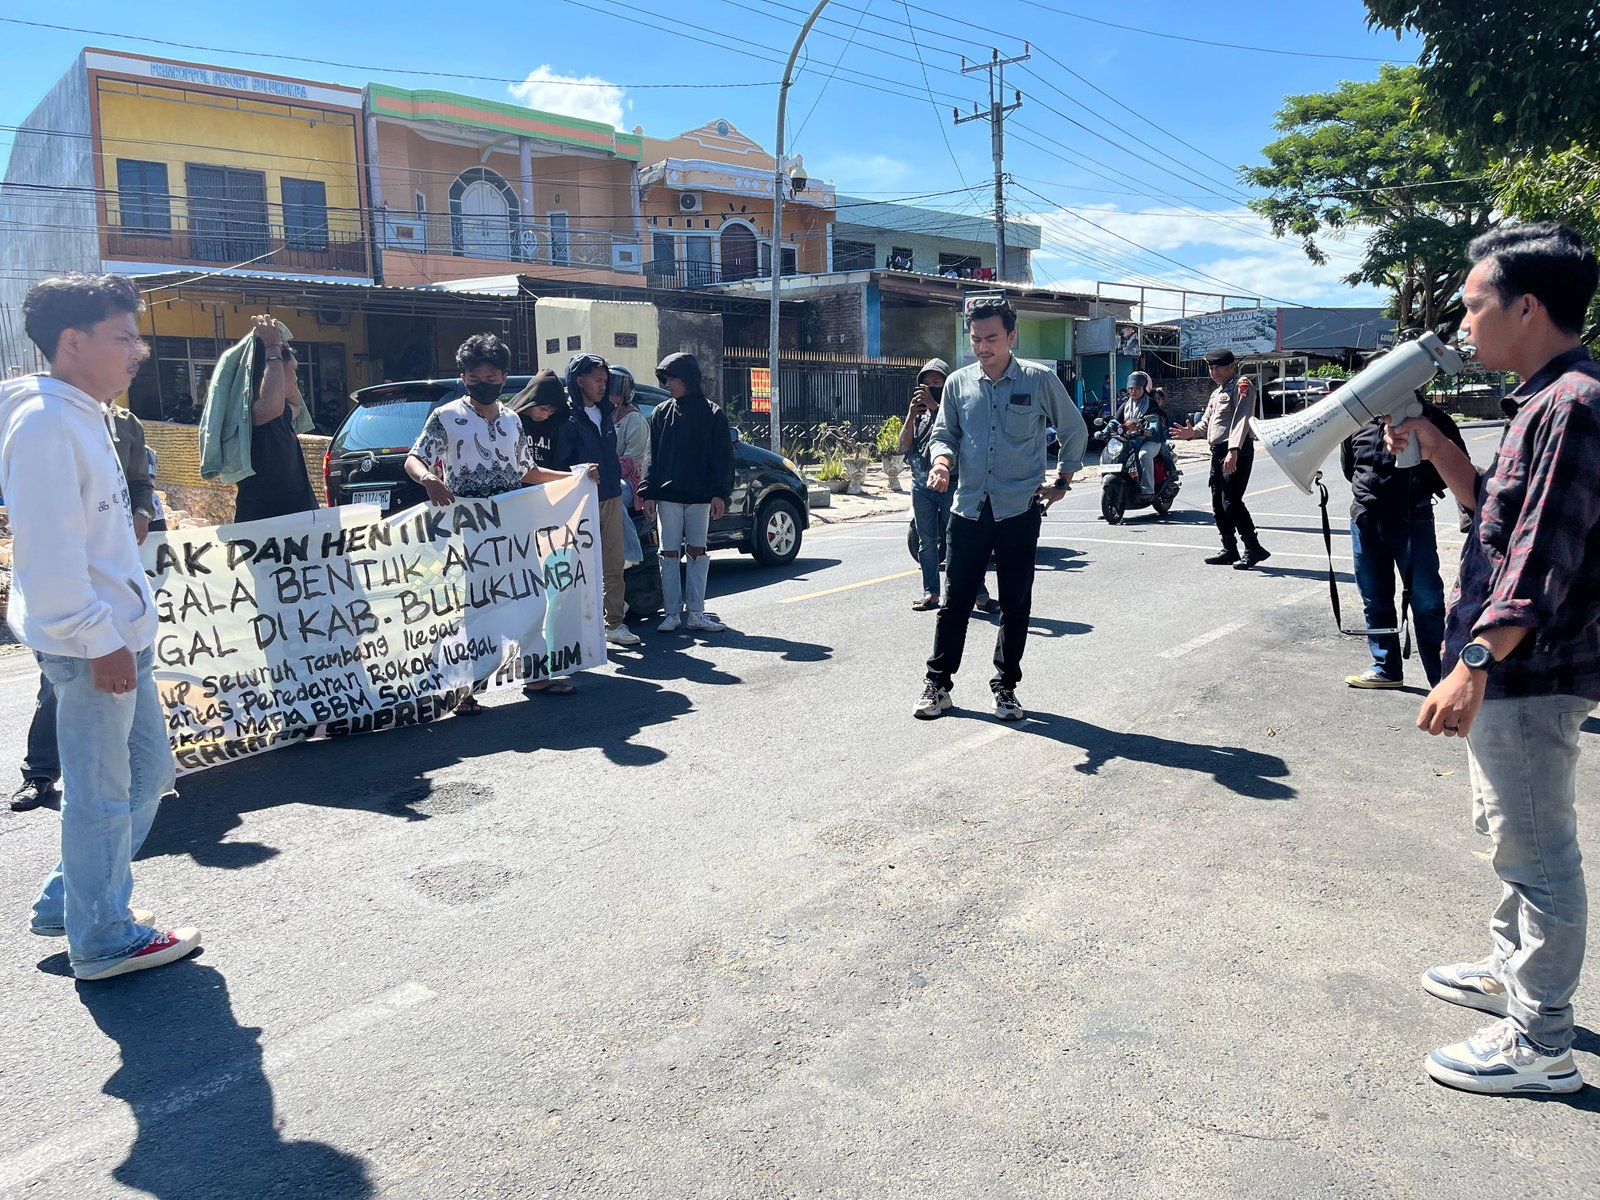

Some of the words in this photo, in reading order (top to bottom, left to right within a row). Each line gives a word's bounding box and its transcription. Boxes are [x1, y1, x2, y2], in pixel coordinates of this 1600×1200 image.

[213, 71, 249, 90] RESORT
[251, 77, 308, 99] BULUKUMBA
[1197, 331, 1218, 341] SAOS
[1201, 316, 1226, 326] RUMAH
[1227, 312, 1253, 322] MAKAN
[145, 541, 213, 578] AK
[226, 534, 309, 571] DAN
[321, 500, 501, 559] HENTIKAN
[269, 553, 424, 605] BENTUK
[443, 518, 594, 577] AKTIVITAS
[248, 611, 288, 651] DI
[394, 559, 587, 625] BULUKUMBA
[300, 635, 389, 676] Tambang
[495, 640, 582, 687] HUKUM
[238, 670, 362, 717] Peredaran
[310, 689, 374, 722] BBM
[378, 672, 445, 709] Solar
